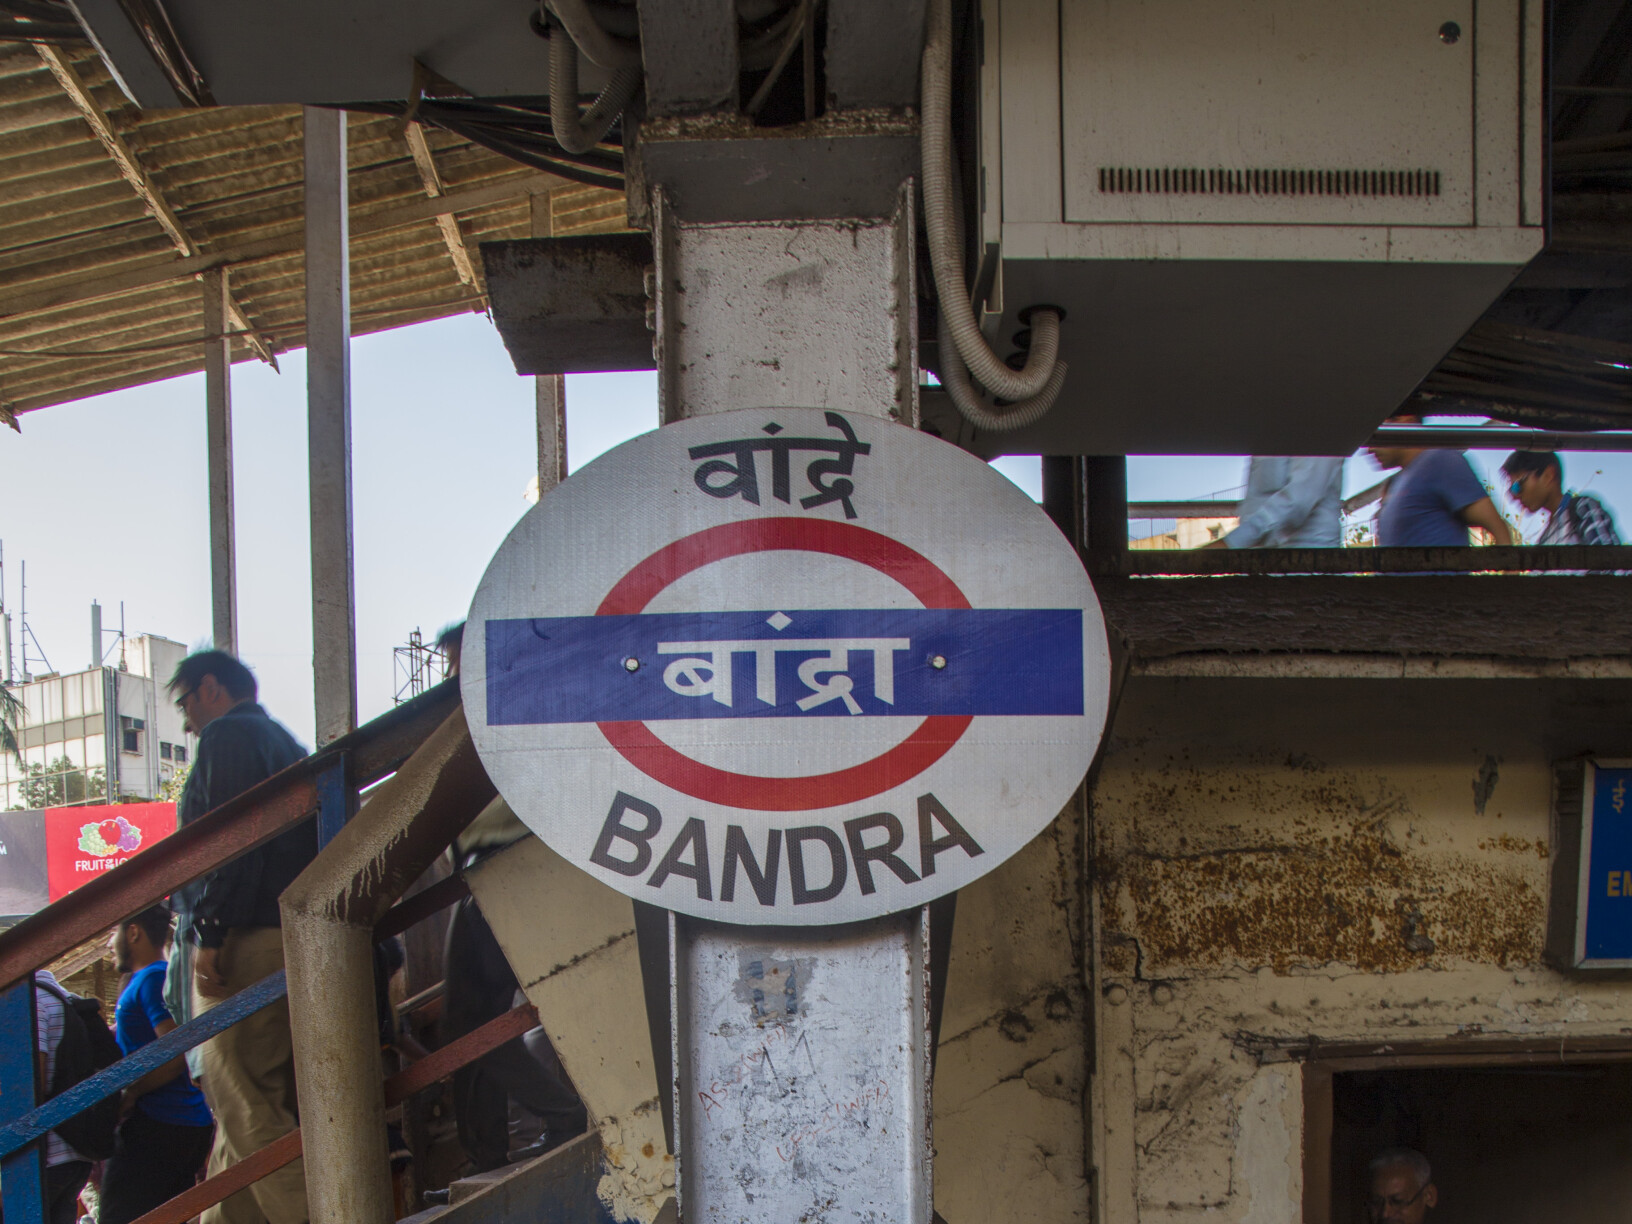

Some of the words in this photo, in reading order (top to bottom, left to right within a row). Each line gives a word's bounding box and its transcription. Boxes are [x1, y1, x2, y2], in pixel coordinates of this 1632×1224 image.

[688, 411, 871, 519] वांद्रे
[657, 611, 910, 715] बांद्रा
[75, 859, 105, 872] FRUIT
[589, 790, 985, 906] BANDRA
